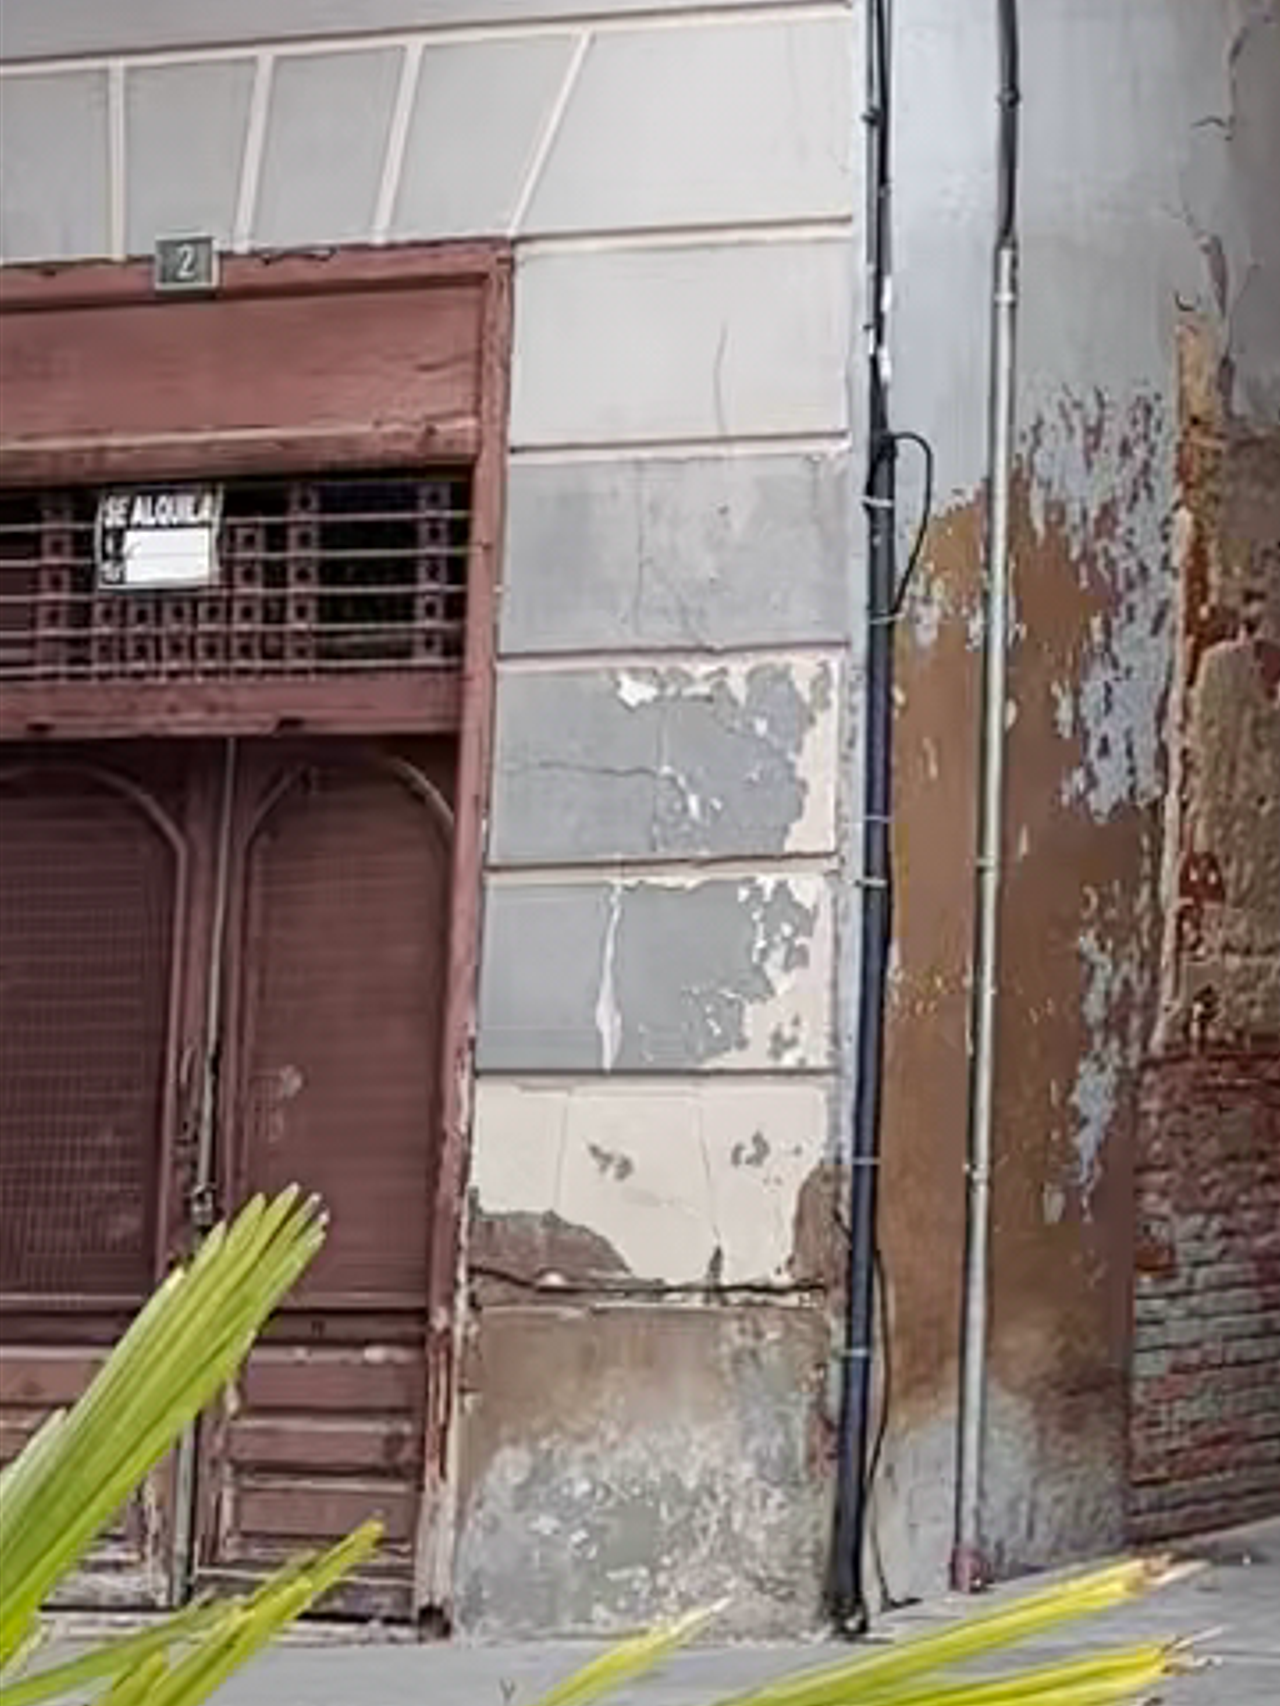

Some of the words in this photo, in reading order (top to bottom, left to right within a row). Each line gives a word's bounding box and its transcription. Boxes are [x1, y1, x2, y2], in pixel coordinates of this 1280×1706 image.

[177, 243, 196, 279] 2
[104, 495, 129, 528] SE
[130, 492, 213, 526] ALQUILA
